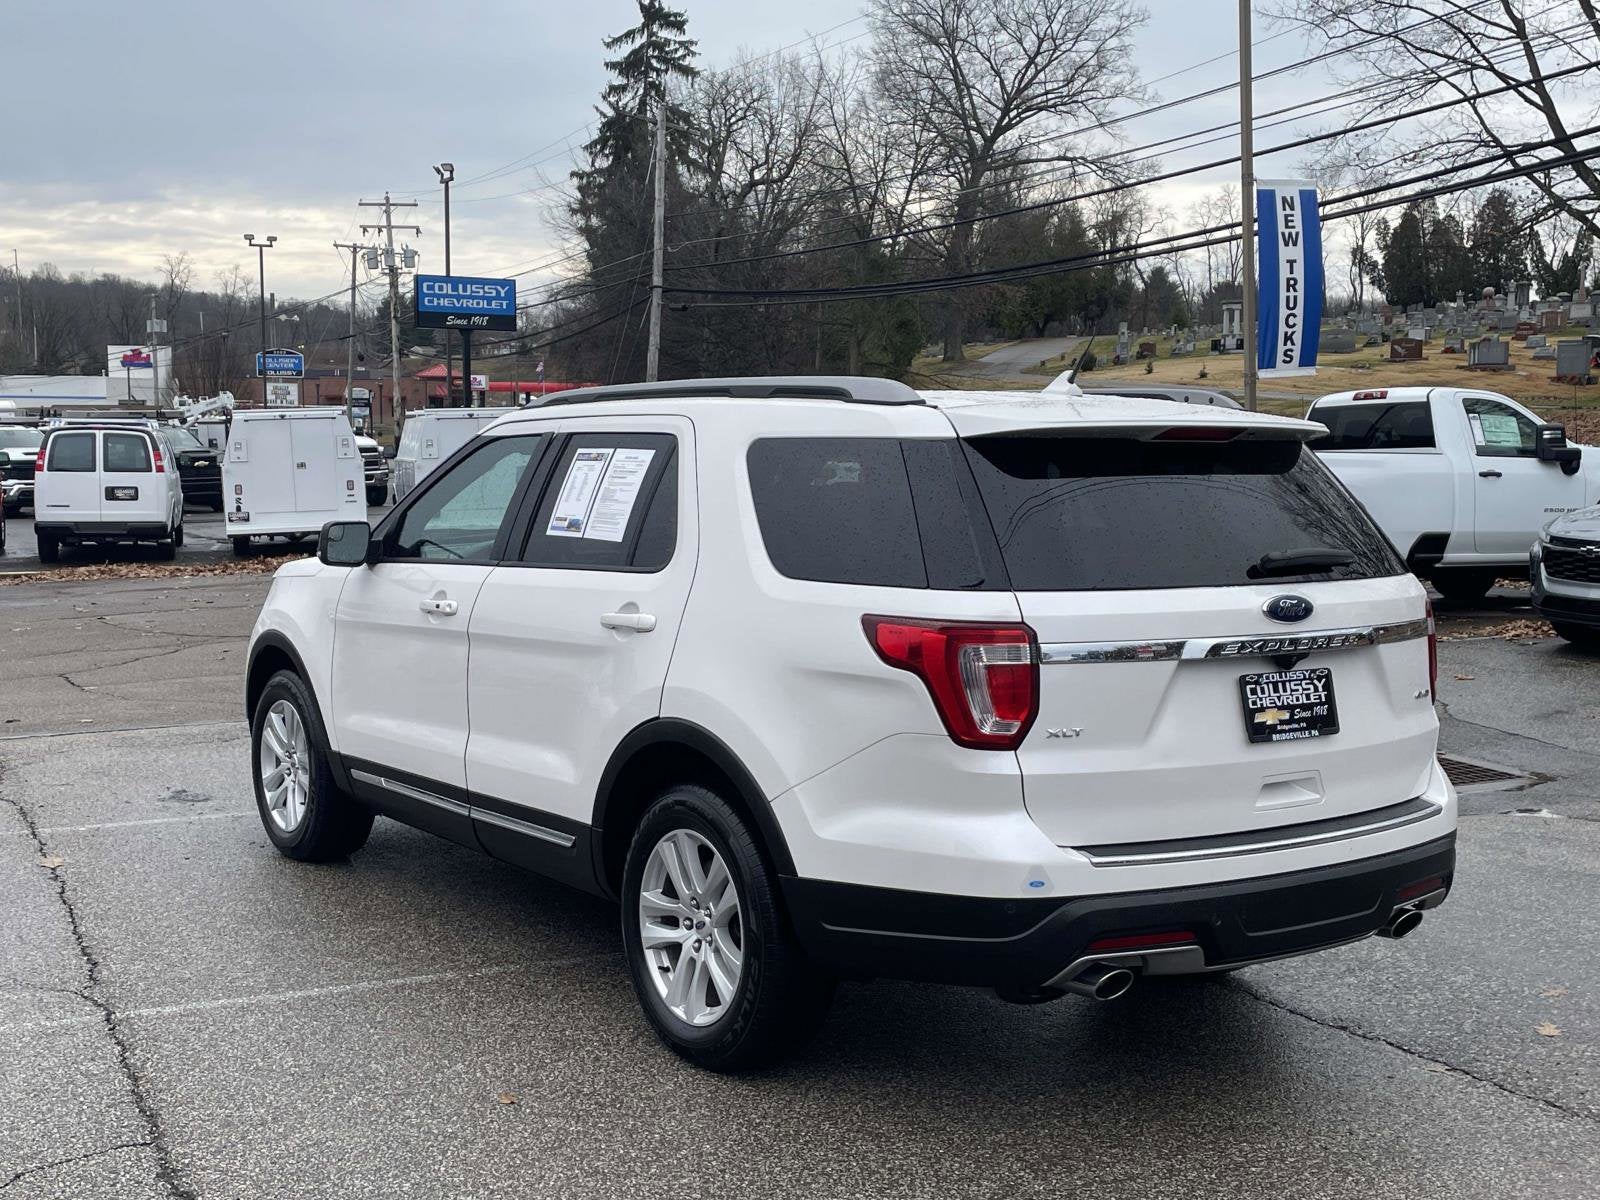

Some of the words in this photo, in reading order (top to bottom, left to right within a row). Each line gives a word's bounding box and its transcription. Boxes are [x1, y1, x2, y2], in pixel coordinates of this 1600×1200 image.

[1280, 195, 1300, 248] NEW
[422, 281, 510, 297] COLUSSY
[424, 296, 510, 310] CHEVROLET
[1281, 258, 1299, 365] TRUCKS
[445, 315, 468, 326] Since
[470, 315, 489, 326] 1918
[1278, 599, 1305, 618] Ford
[1220, 636, 1360, 655] EXPLORER
[1263, 670, 1311, 682] COLUSSY
[1246, 678, 1326, 698] COLUSSY
[1248, 691, 1328, 709] CHEVROLET
[1294, 708, 1312, 719] Since
[1313, 704, 1329, 716] 1918
[1046, 727, 1084, 739] XLT
[1311, 729, 1320, 738] PA
